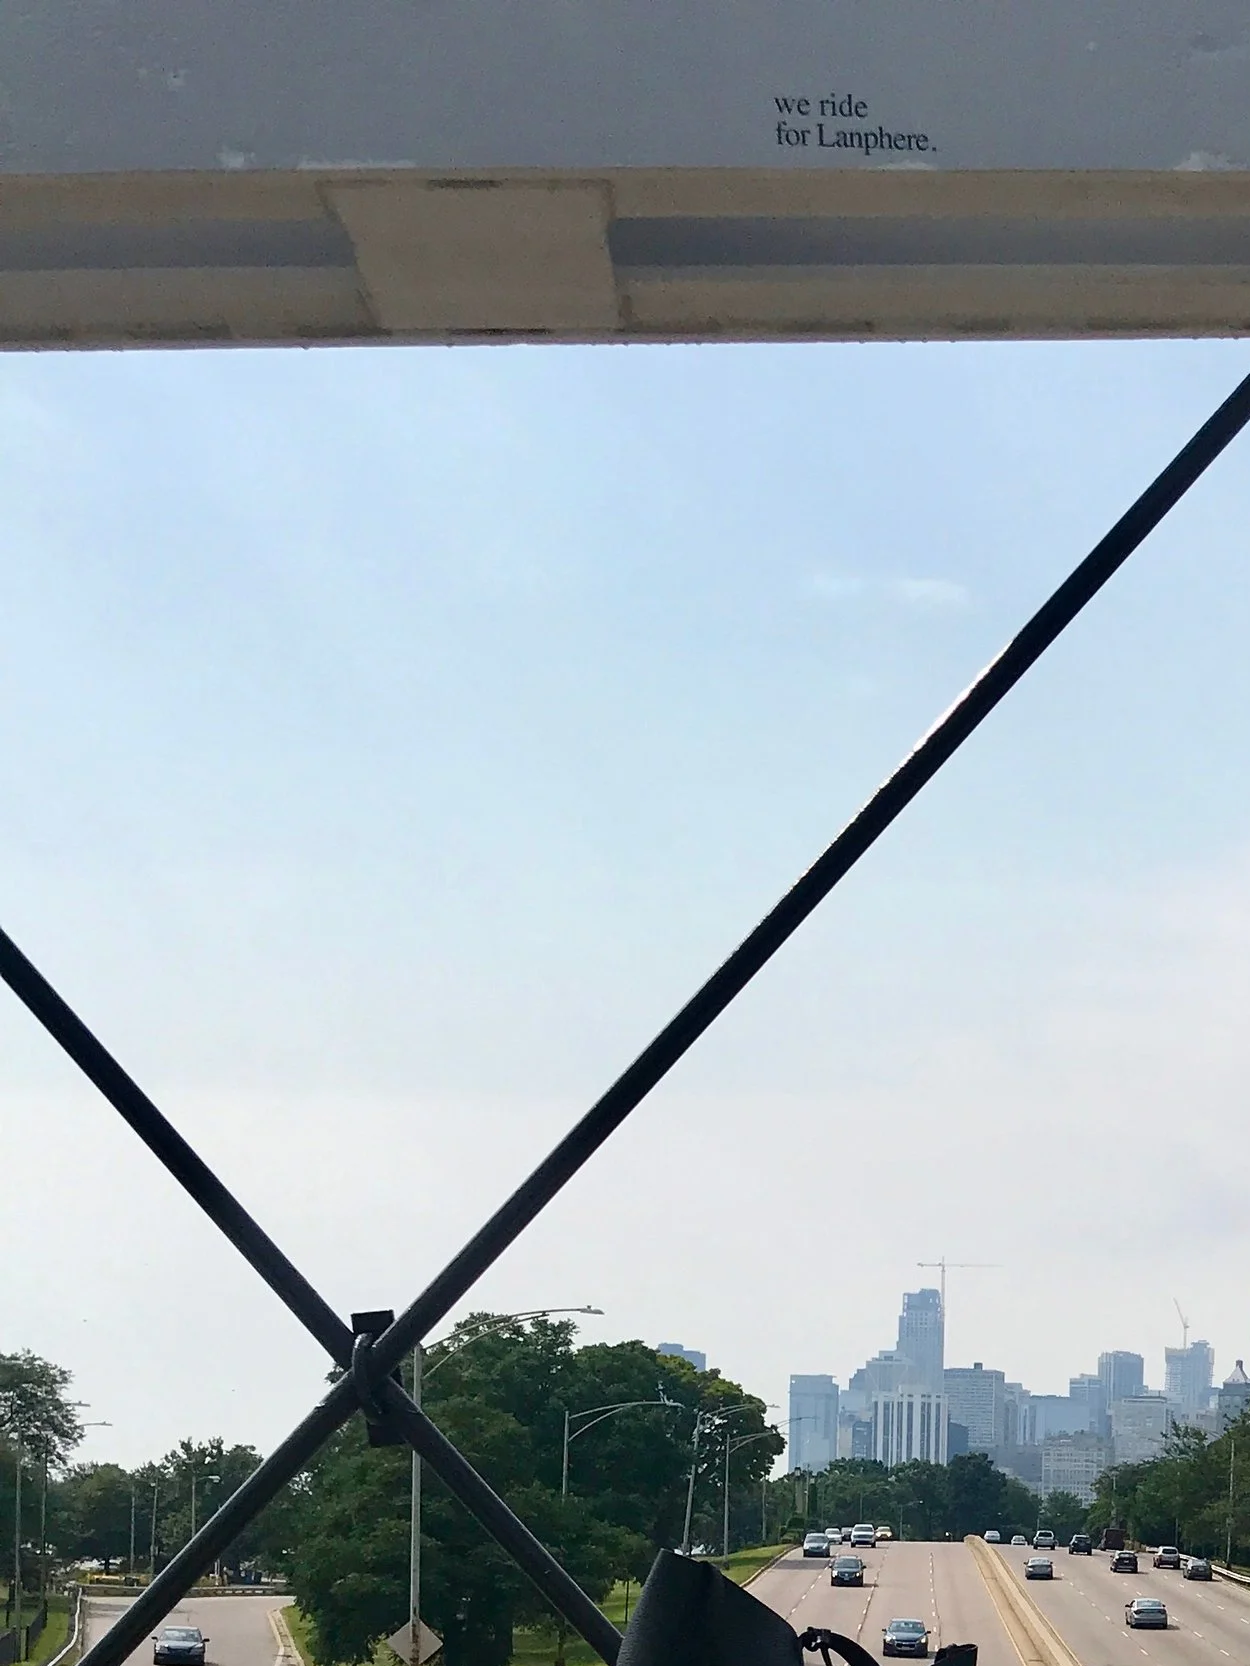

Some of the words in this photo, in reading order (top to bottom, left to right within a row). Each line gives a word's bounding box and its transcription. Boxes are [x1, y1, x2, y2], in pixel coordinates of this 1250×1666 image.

[774, 96, 811, 116] we
[820, 93, 868, 118] ride
[776, 121, 811, 146] for
[817, 123, 937, 156] Lanphere.
